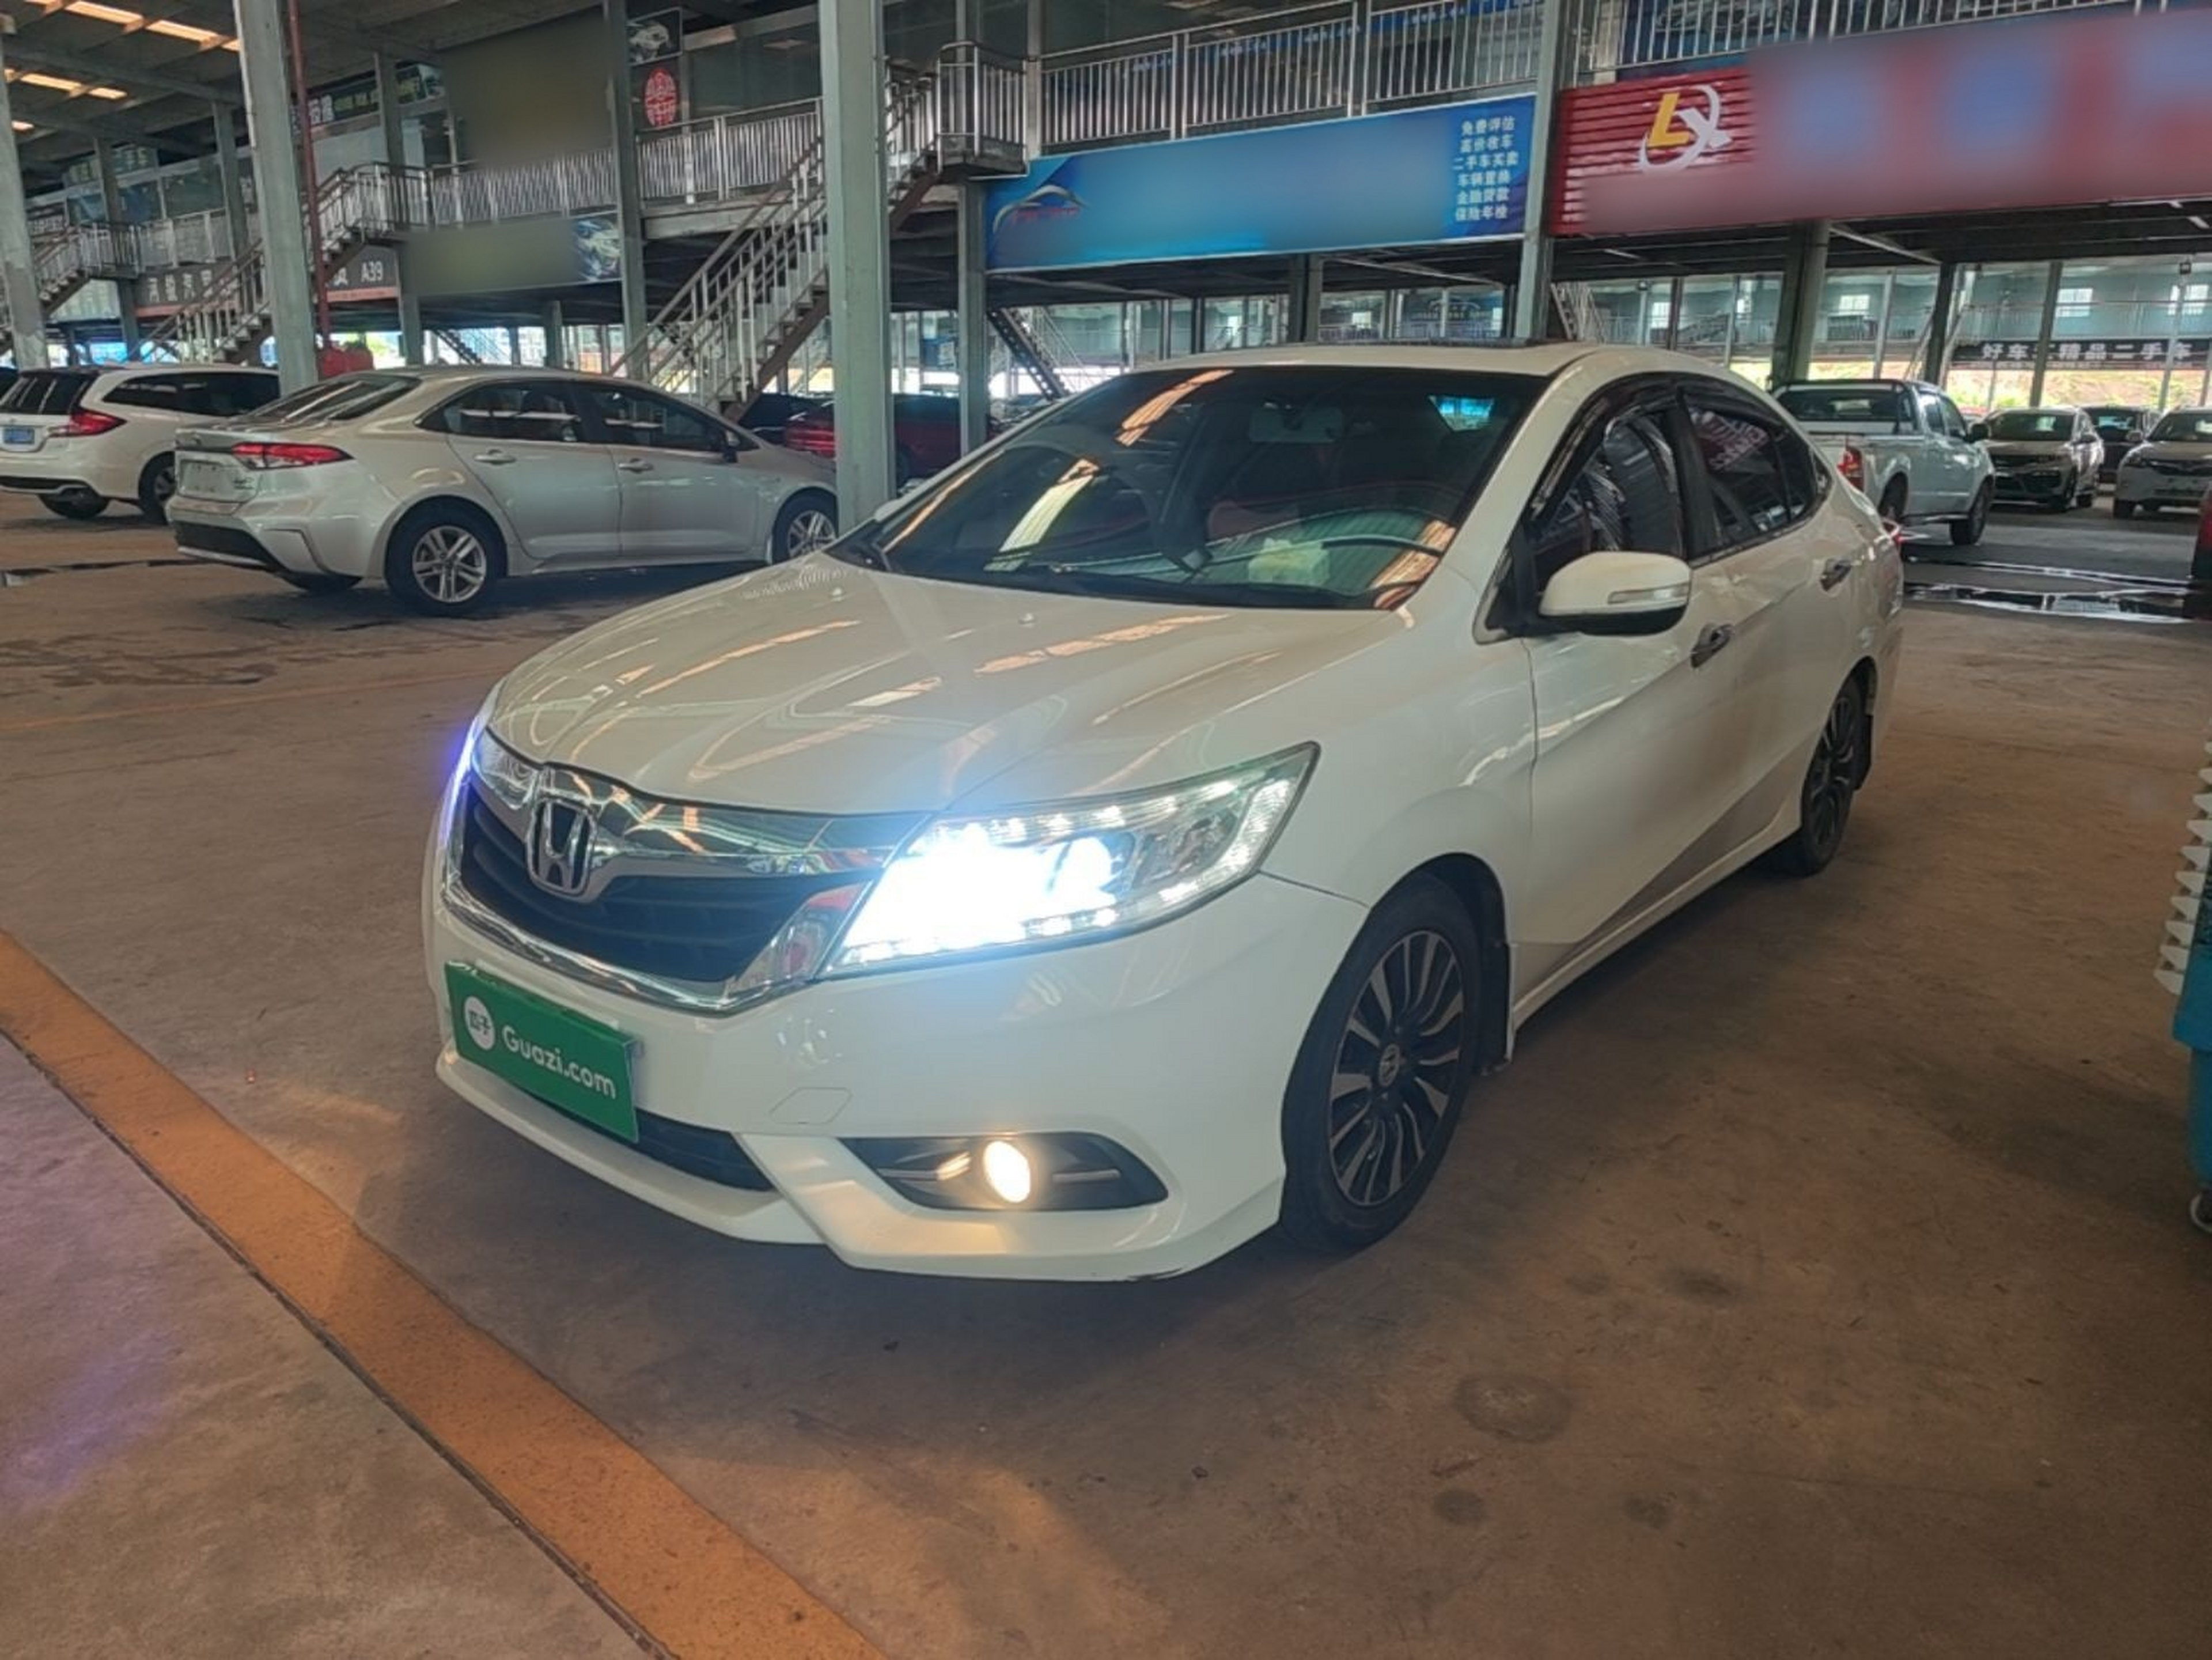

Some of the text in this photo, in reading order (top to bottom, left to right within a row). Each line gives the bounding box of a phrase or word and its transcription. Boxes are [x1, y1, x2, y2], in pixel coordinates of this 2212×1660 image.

[1462, 116, 1514, 135] 免费评估
[1460, 134, 1513, 153] 高价收车
[1453, 150, 1518, 169] 二手车买卖
[1458, 169, 1510, 187] 车辆置换
[1457, 187, 1509, 205] 金融贷款
[361, 260, 384, 282] A39
[502, 1025, 616, 1099] Guazi.com
